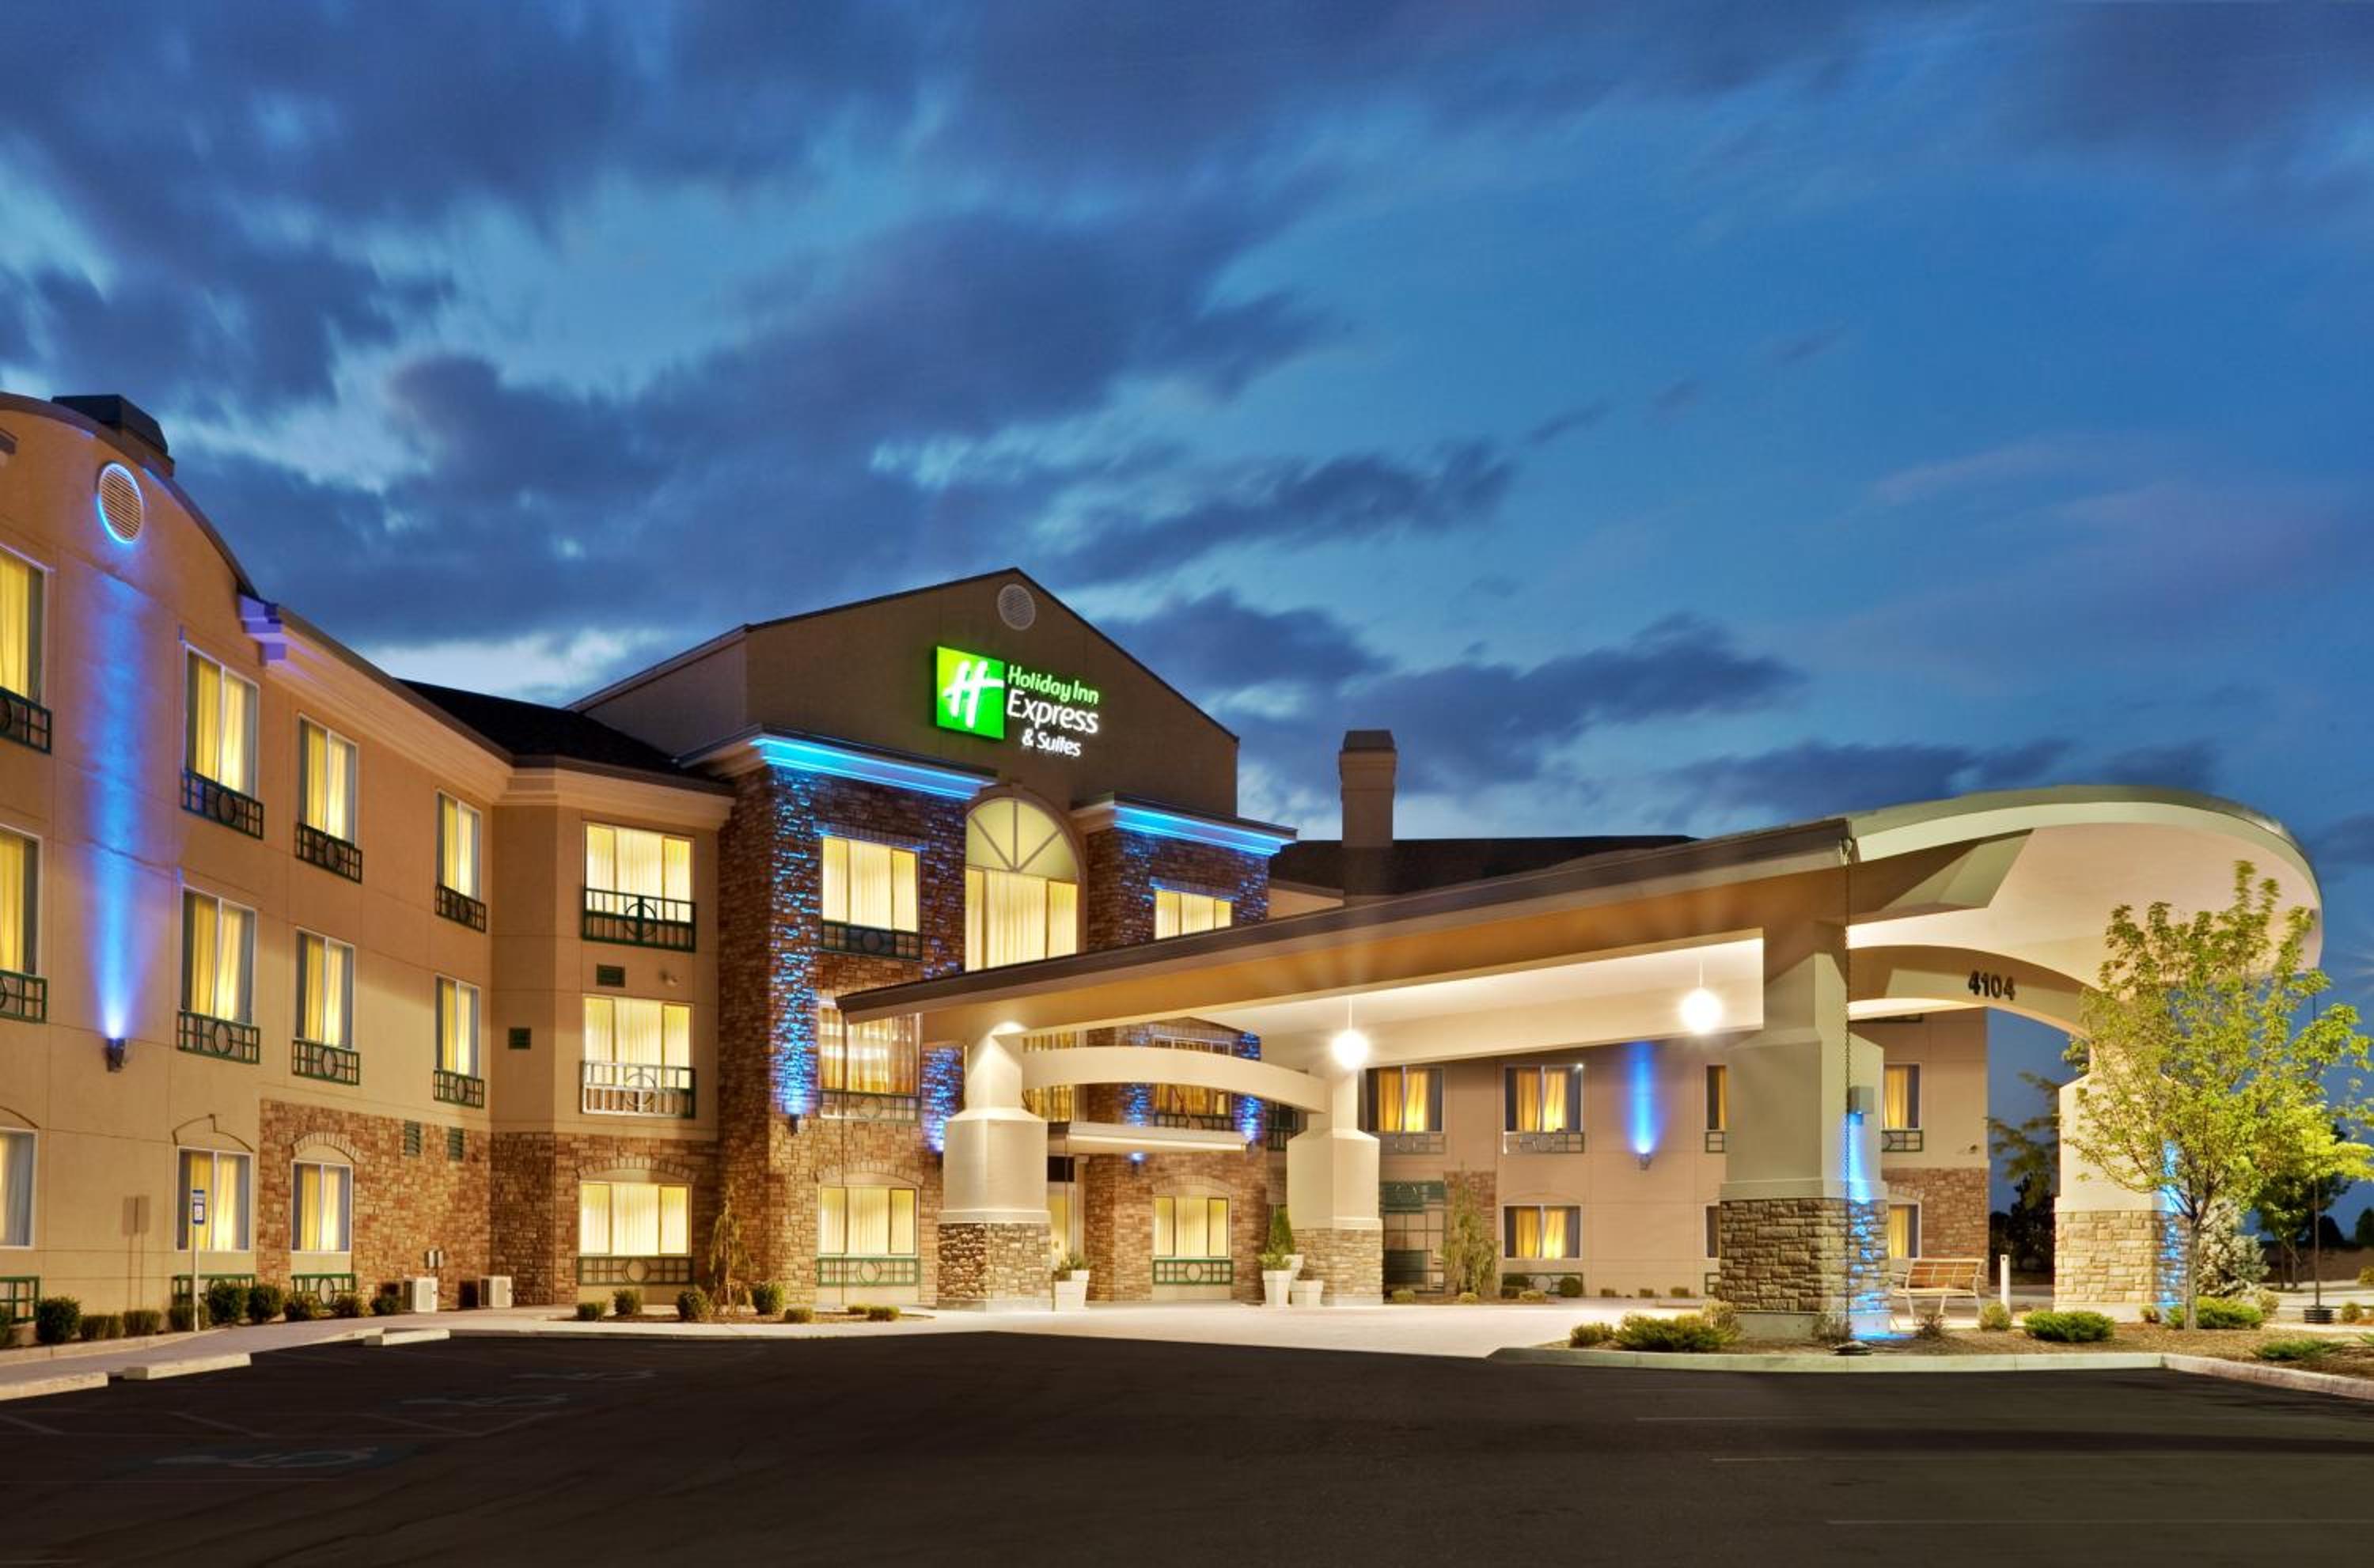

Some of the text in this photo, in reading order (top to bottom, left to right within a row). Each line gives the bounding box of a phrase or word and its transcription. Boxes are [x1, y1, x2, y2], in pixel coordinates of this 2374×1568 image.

[1008, 665, 1099, 705] Holiday Inn
[1007, 689, 1098, 733] Express
[1022, 729, 1081, 756] & Suites
[1968, 970, 2015, 1000] 4104
